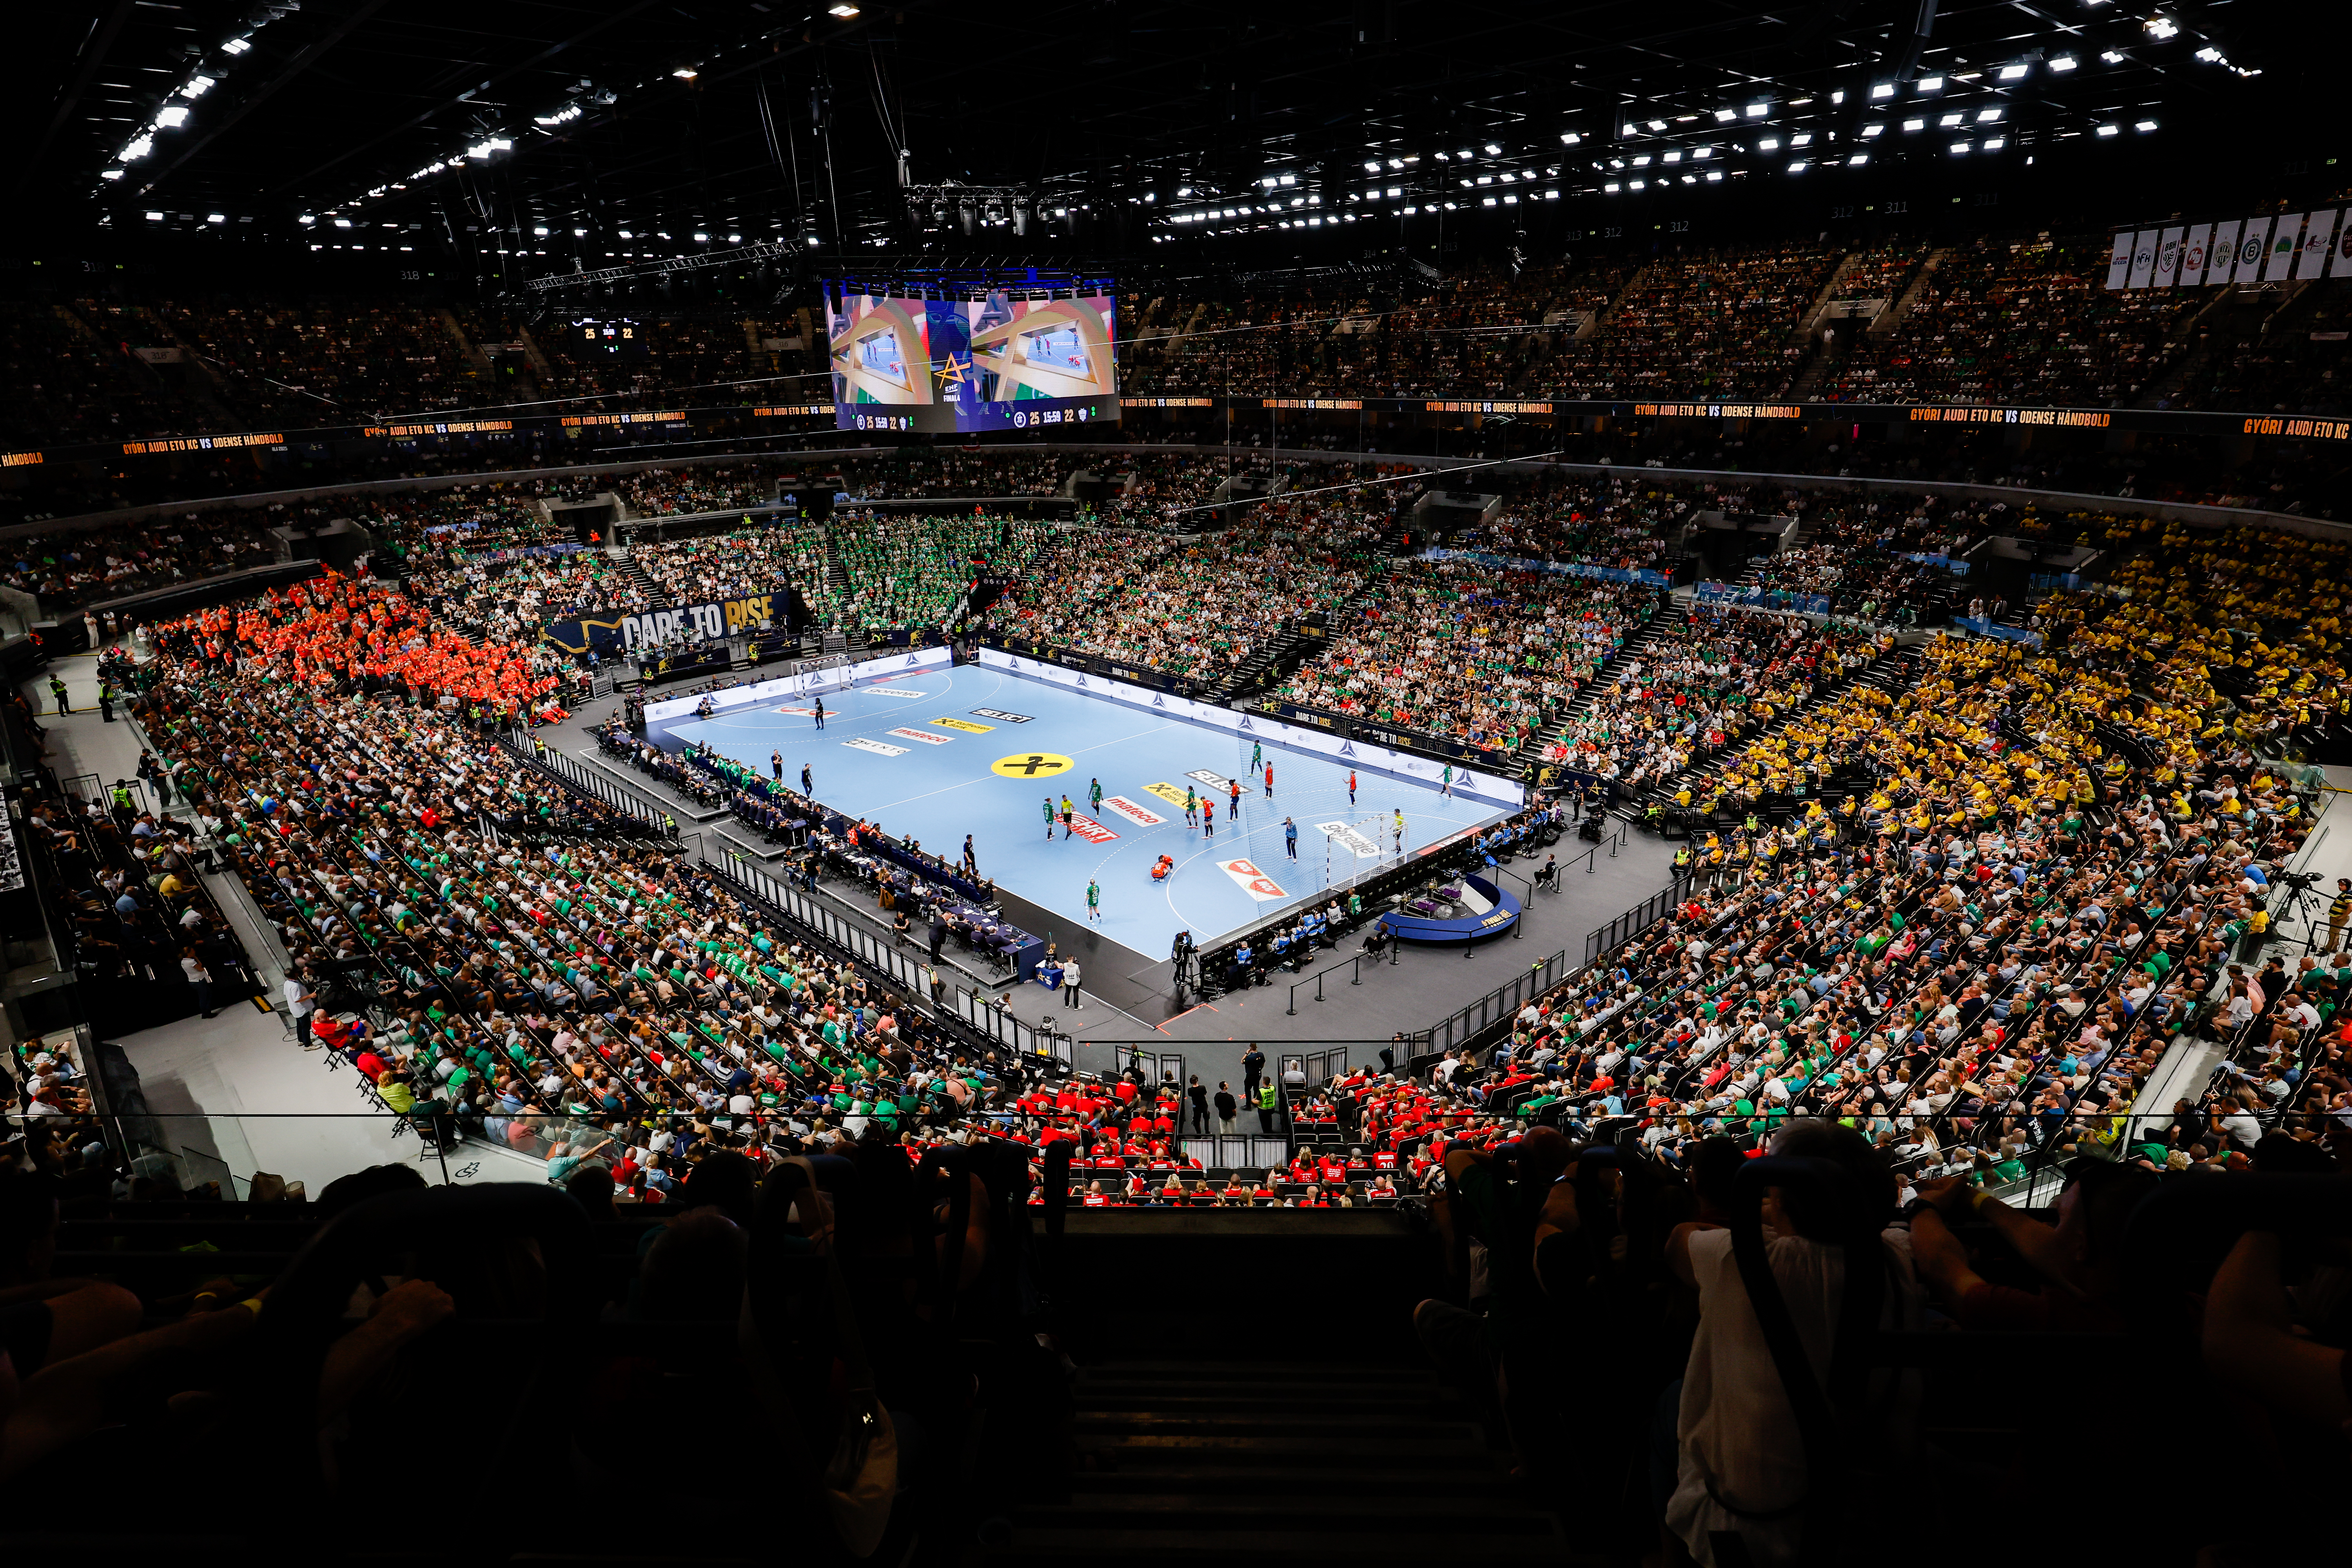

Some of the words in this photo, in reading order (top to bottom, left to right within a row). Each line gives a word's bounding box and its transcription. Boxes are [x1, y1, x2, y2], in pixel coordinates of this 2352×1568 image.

[1831, 206, 1854, 218] 312
[1885, 201, 1907, 214] 311
[1604, 227, 1622, 238] 312
[1670, 221, 1689, 232] 312
[1565, 230, 1582, 241] 313
[1443, 241, 1457, 252] 313
[2165, 240, 2177, 252] BBH
[1363, 249, 1376, 258] 314
[82, 261, 105, 272] 318
[399, 270, 419, 279] 318
[806, 274, 822, 282] 316
[585, 328, 595, 339] 25
[622, 328, 633, 339] 22
[945, 383, 958, 392] EHF
[943, 394, 960, 402] FINAL4
[1166, 398, 1186, 407] ODENSE
[1187, 397, 1212, 407] HÅNDBOLD
[1278, 399, 1289, 408] AUDI
[1290, 399, 1299, 408] ETO
[1300, 400, 1307, 408] KC
[1308, 400, 1314, 408] VS
[1316, 400, 1334, 409] ODENSE
[1336, 398, 1362, 409] HÅNDBOLD
[774, 407, 788, 416] AUDI
[789, 407, 800, 415] ETO
[801, 407, 809, 415] KC
[810, 406, 818, 414] VS
[1445, 402, 1459, 411] AUDI
[1461, 402, 1472, 412] ETO
[1473, 403, 1481, 412] KC
[1483, 403, 1492, 412] VS
[1493, 403, 1516, 412] ODENSE
[1518, 401, 1552, 413] HÅNDBOLD
[1635, 403, 1657, 415] GYŐRI
[1660, 405, 1677, 416] AUDI
[1679, 405, 1693, 416] ETO
[1696, 406, 1706, 416] KC
[1709, 406, 1720, 417] VS
[1722, 406, 1753, 417] ODENSE
[1755, 404, 1800, 418] HÅNDBOLD
[583, 417, 597, 425] AUDI
[598, 416, 610, 425] ETO
[611, 416, 620, 424] KC
[621, 415, 630, 423] VS
[631, 414, 653, 423] ODENSE
[655, 412, 685, 421] HÅNDBOLD
[1030, 411, 1040, 425] 25
[1043, 410, 1062, 423] 15:59
[1064, 409, 1074, 423] 22
[1911, 406, 1940, 421] GYŐRI
[1944, 409, 1968, 421] AUDI
[1971, 409, 1988, 422] ETO
[1991, 410, 2003, 423] KC
[2006, 410, 2017, 423] VS
[2020, 410, 2055, 425] ODENSE
[2057, 410, 2110, 427] HÅNDBOLD
[390, 424, 407, 435] AUDI
[408, 423, 423, 434] ETO
[424, 425, 435, 434] KC
[436, 424, 446, 434] VS
[448, 422, 475, 433] ODENSE
[475, 421, 512, 431] HÅNDBOLD
[867, 416, 874, 429] 25
[875, 416, 888, 429] 15:59
[889, 416, 897, 430] 22
[2244, 417, 2283, 434] GYŐRI
[2285, 420, 2314, 436] AUDI
[2314, 422, 2333, 437] ETO
[2334, 423, 2349, 439] KC
[149, 441, 168, 452] AUDI
[169, 440, 185, 451] ETO
[187, 439, 198, 450] KC
[200, 438, 212, 449] VS
[213, 436, 243, 448] ODENSE
[244, 434, 283, 446] HÅNDBOLD
[2, 452, 43, 467] HÅNDBOLD
[622, 609, 685, 651] DARE
[688, 604, 723, 642] TO
[724, 595, 774, 635] RISE
[1112, 667, 1123, 677] DARE
[1129, 672, 1139, 680] RISE
[868, 688, 918, 697] gorenje
[973, 709, 1032, 723] SELECT
[1296, 711, 1310, 723] DARE
[1310, 715, 1318, 724] TO
[1318, 716, 1331, 727] RISE
[955, 721, 991, 731] Raiffeisen
[895, 727, 948, 742] mateco
[1389, 733, 1397, 744] TO
[1397, 735, 1411, 747] RISE
[1161, 792, 1180, 802] Bank
[1107, 798, 1158, 823] mateco
[1076, 822, 1117, 839] HRT
[1234, 862, 1253, 872] MOL
[1256, 881, 1276, 891] MOL
